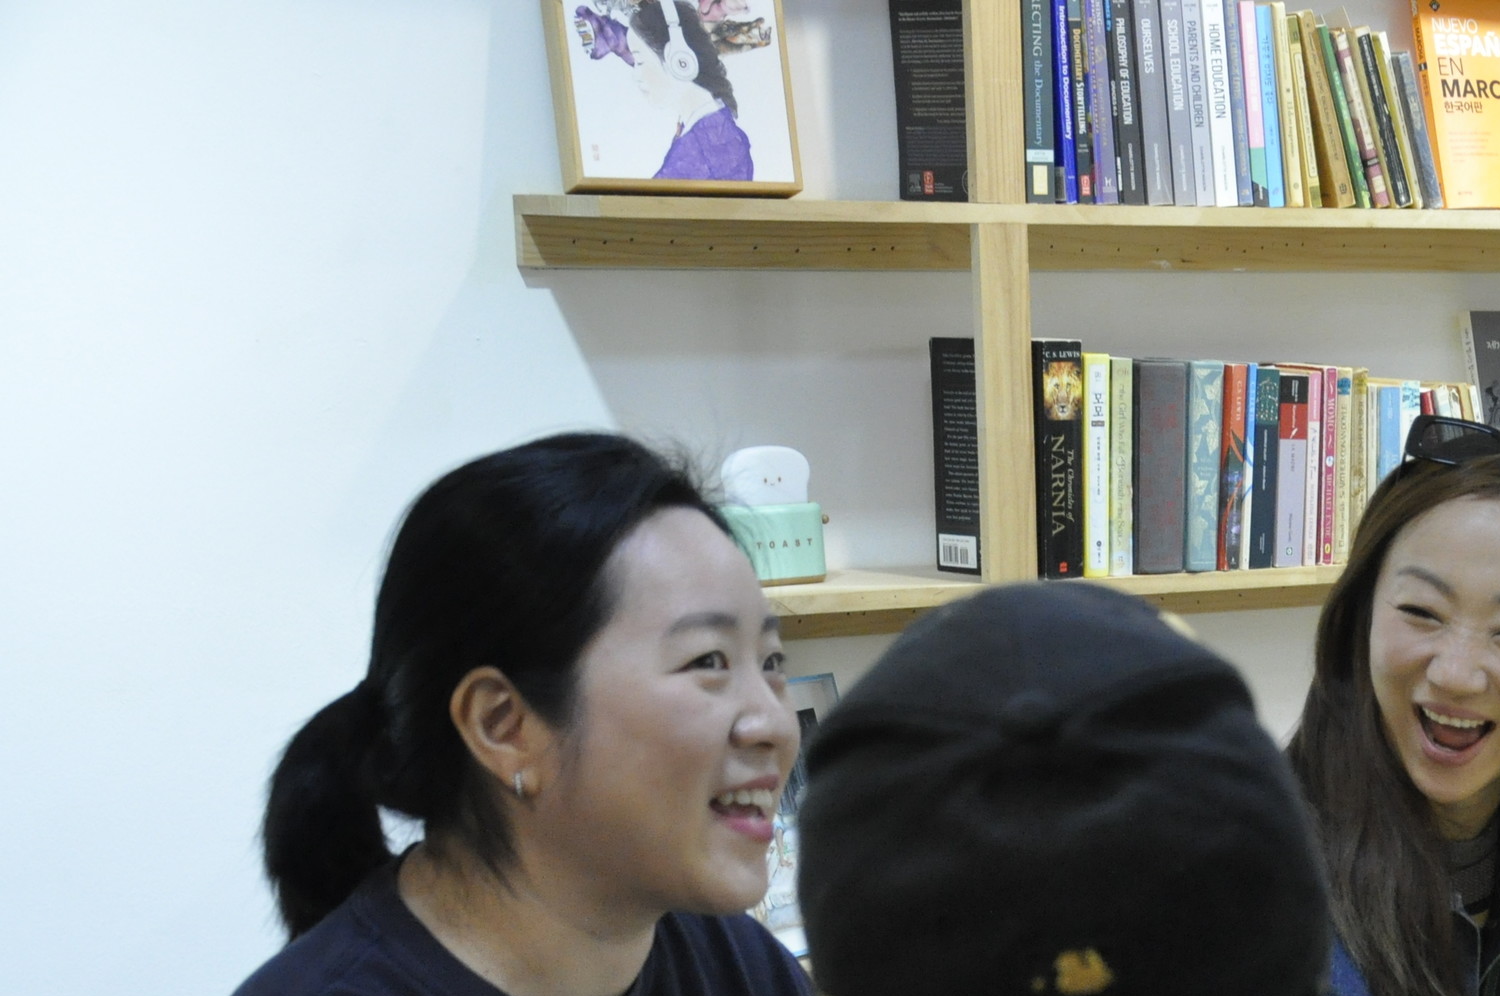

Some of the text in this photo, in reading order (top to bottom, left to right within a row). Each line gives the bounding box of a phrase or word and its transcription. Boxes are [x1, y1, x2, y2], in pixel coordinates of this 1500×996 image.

[1116, 18, 1128, 69] PHILOSOPHY
[1141, 18, 1154, 74] OURSELVES
[1431, 17, 1478, 33] NUEVO
[1058, 5, 1073, 141] Introduction to Documentary
[1121, 69, 1129, 79] OF
[1167, 19, 1184, 111] SCHOOL EDUCATION
[1187, 20, 1204, 128] PARENTS AND CHILDREN
[1209, 23, 1226, 119] HOME EDUCATION
[1438, 56, 1465, 76] EN
[1034, 78, 1043, 147] Documentary
[1121, 80, 1132, 125] EDUCATION
[1444, 101, 1483, 114] 한국어판
[1059, 350, 1081, 358] LEWIS
[1051, 434, 1066, 537] NARNIA
[1066, 449, 1075, 523] The Chronicles of
[756, 537, 813, 549] TOAST
